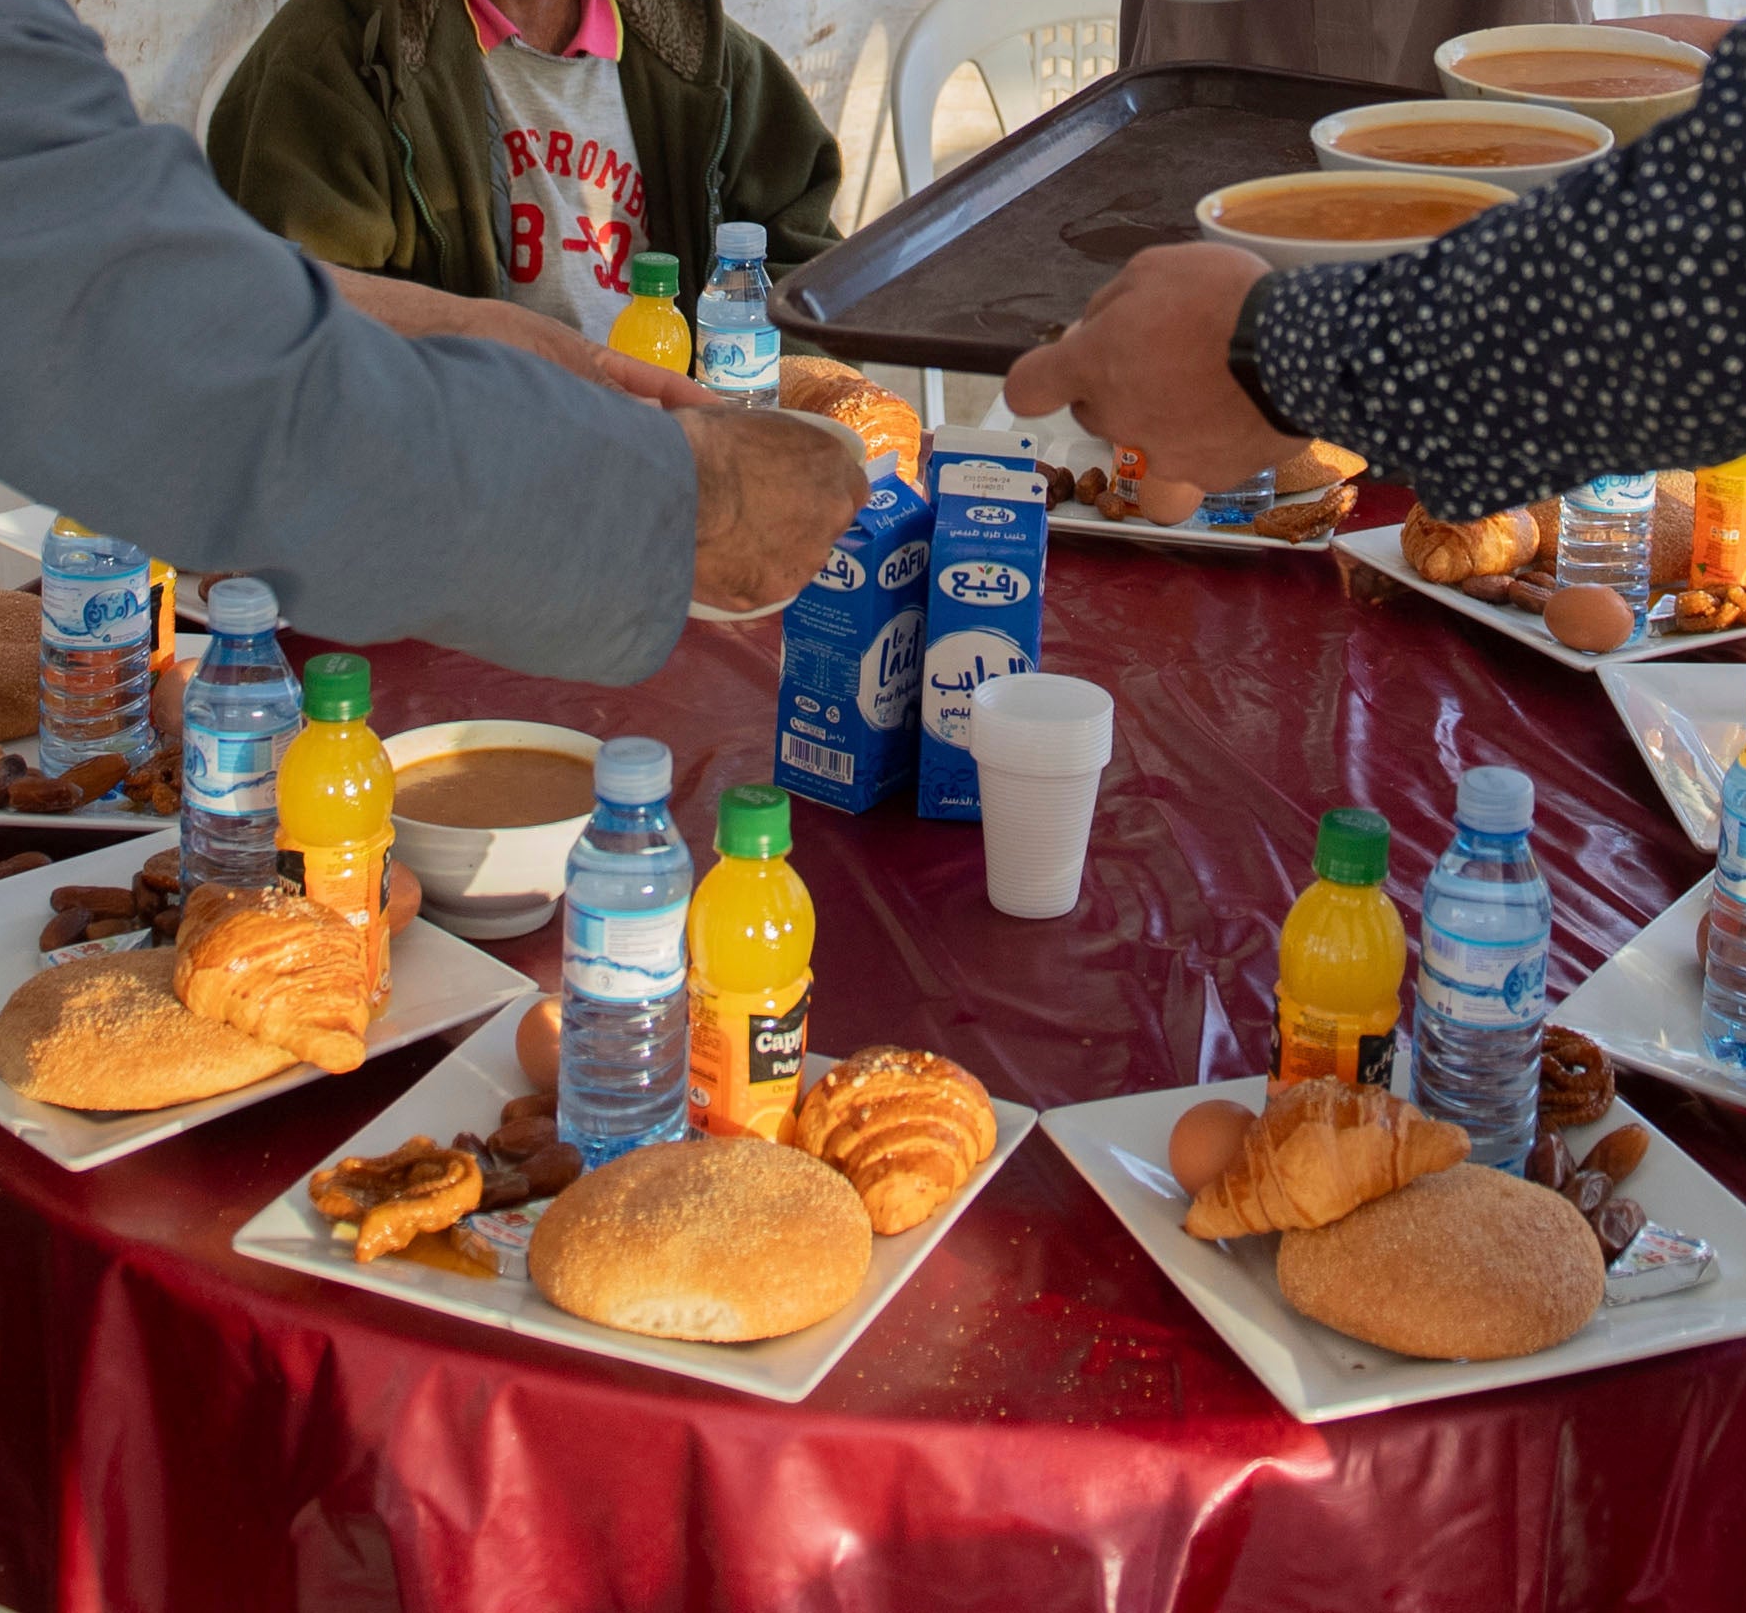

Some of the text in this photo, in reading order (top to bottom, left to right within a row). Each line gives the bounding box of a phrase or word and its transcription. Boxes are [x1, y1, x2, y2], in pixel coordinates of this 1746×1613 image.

[504, 129, 649, 234] RROMB
[820, 553, 855, 588] رفي
[951, 567, 1019, 601] رفيع
[940, 707, 971, 720] بيعي
